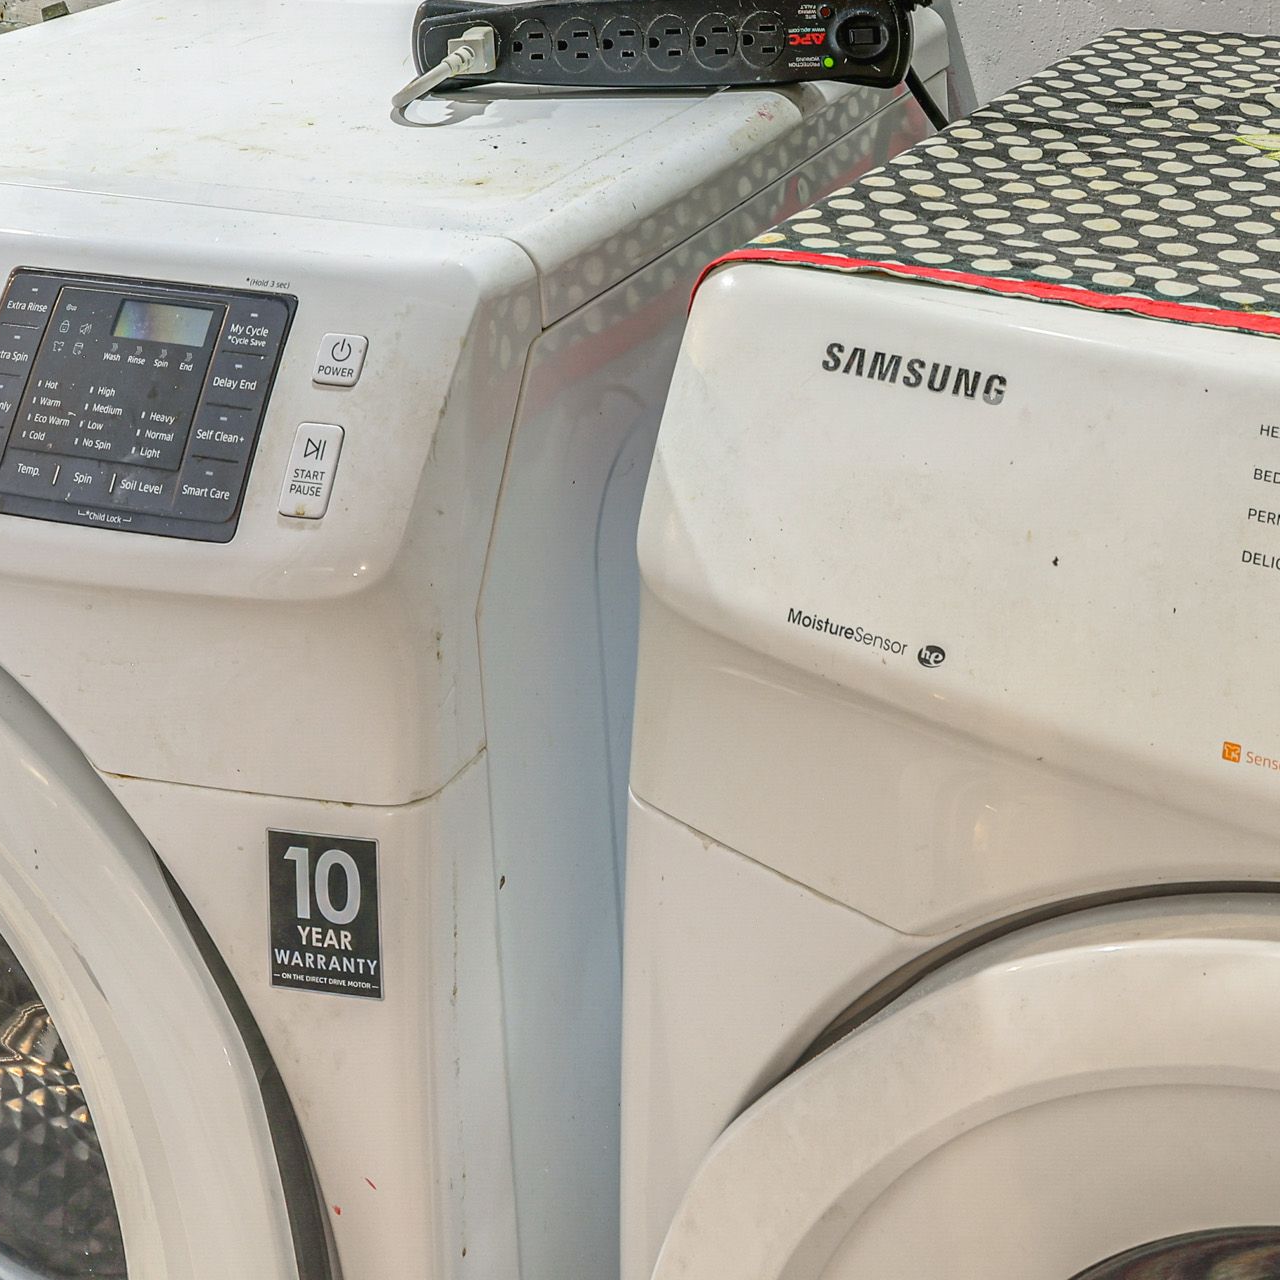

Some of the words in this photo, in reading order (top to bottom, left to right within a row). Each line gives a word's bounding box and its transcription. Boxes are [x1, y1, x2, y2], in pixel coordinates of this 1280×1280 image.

[788, 32, 827, 45] APC
[7, 300, 27, 311] Extra
[27, 302, 48, 313] Rinse
[230, 323, 245, 335] My
[245, 325, 269, 338] Cycle
[250, 337, 266, 348] Save
[12, 351, 29, 363] Spin
[103, 352, 121, 362] Wash
[127, 355, 146, 365] Rinse
[153, 359, 169, 368] Spin
[179, 362, 193, 371] End
[318, 365, 354, 378] POWER
[822, 342, 1007, 406] SAMSUNG
[45, 380, 58, 390] Hot
[212, 376, 238, 390] Delay
[239, 379, 257, 391] End
[97, 387, 116, 397] High
[40, 397, 61, 408] Warm
[92, 404, 123, 416] Medium
[34, 413, 48, 424] Eco
[48, 416, 70, 427] Warm
[149, 412, 176, 425] Heavy
[87, 420, 103, 431] Low
[29, 431, 45, 441] Cold
[144, 429, 174, 442] Normal
[196, 428, 213, 441] Self
[82, 439, 94, 448] No
[94, 440, 112, 451] Spin
[139, 447, 161, 459] Light
[17, 463, 40, 477] Temp.
[294, 468, 326, 481] START
[73, 472, 92, 484] Spin
[120, 479, 137, 492] Soil
[138, 481, 163, 495] Level
[182, 484, 208, 498] Smart
[209, 488, 230, 500] Care
[289, 484, 322, 497] PAUSE
[105, 513, 122, 524] Lock
[787, 607, 908, 655] MoistureSensor
[283, 846, 361, 925] 10
[297, 925, 352, 951] YEAR
[274, 948, 377, 976] WARRANTY
[281, 972, 293, 980] ON
[293, 973, 305, 981] THE
[306, 975, 328, 985] DIRECT
[328, 978, 347, 987] DRIVE
[347, 980, 371, 990] MOTOR
